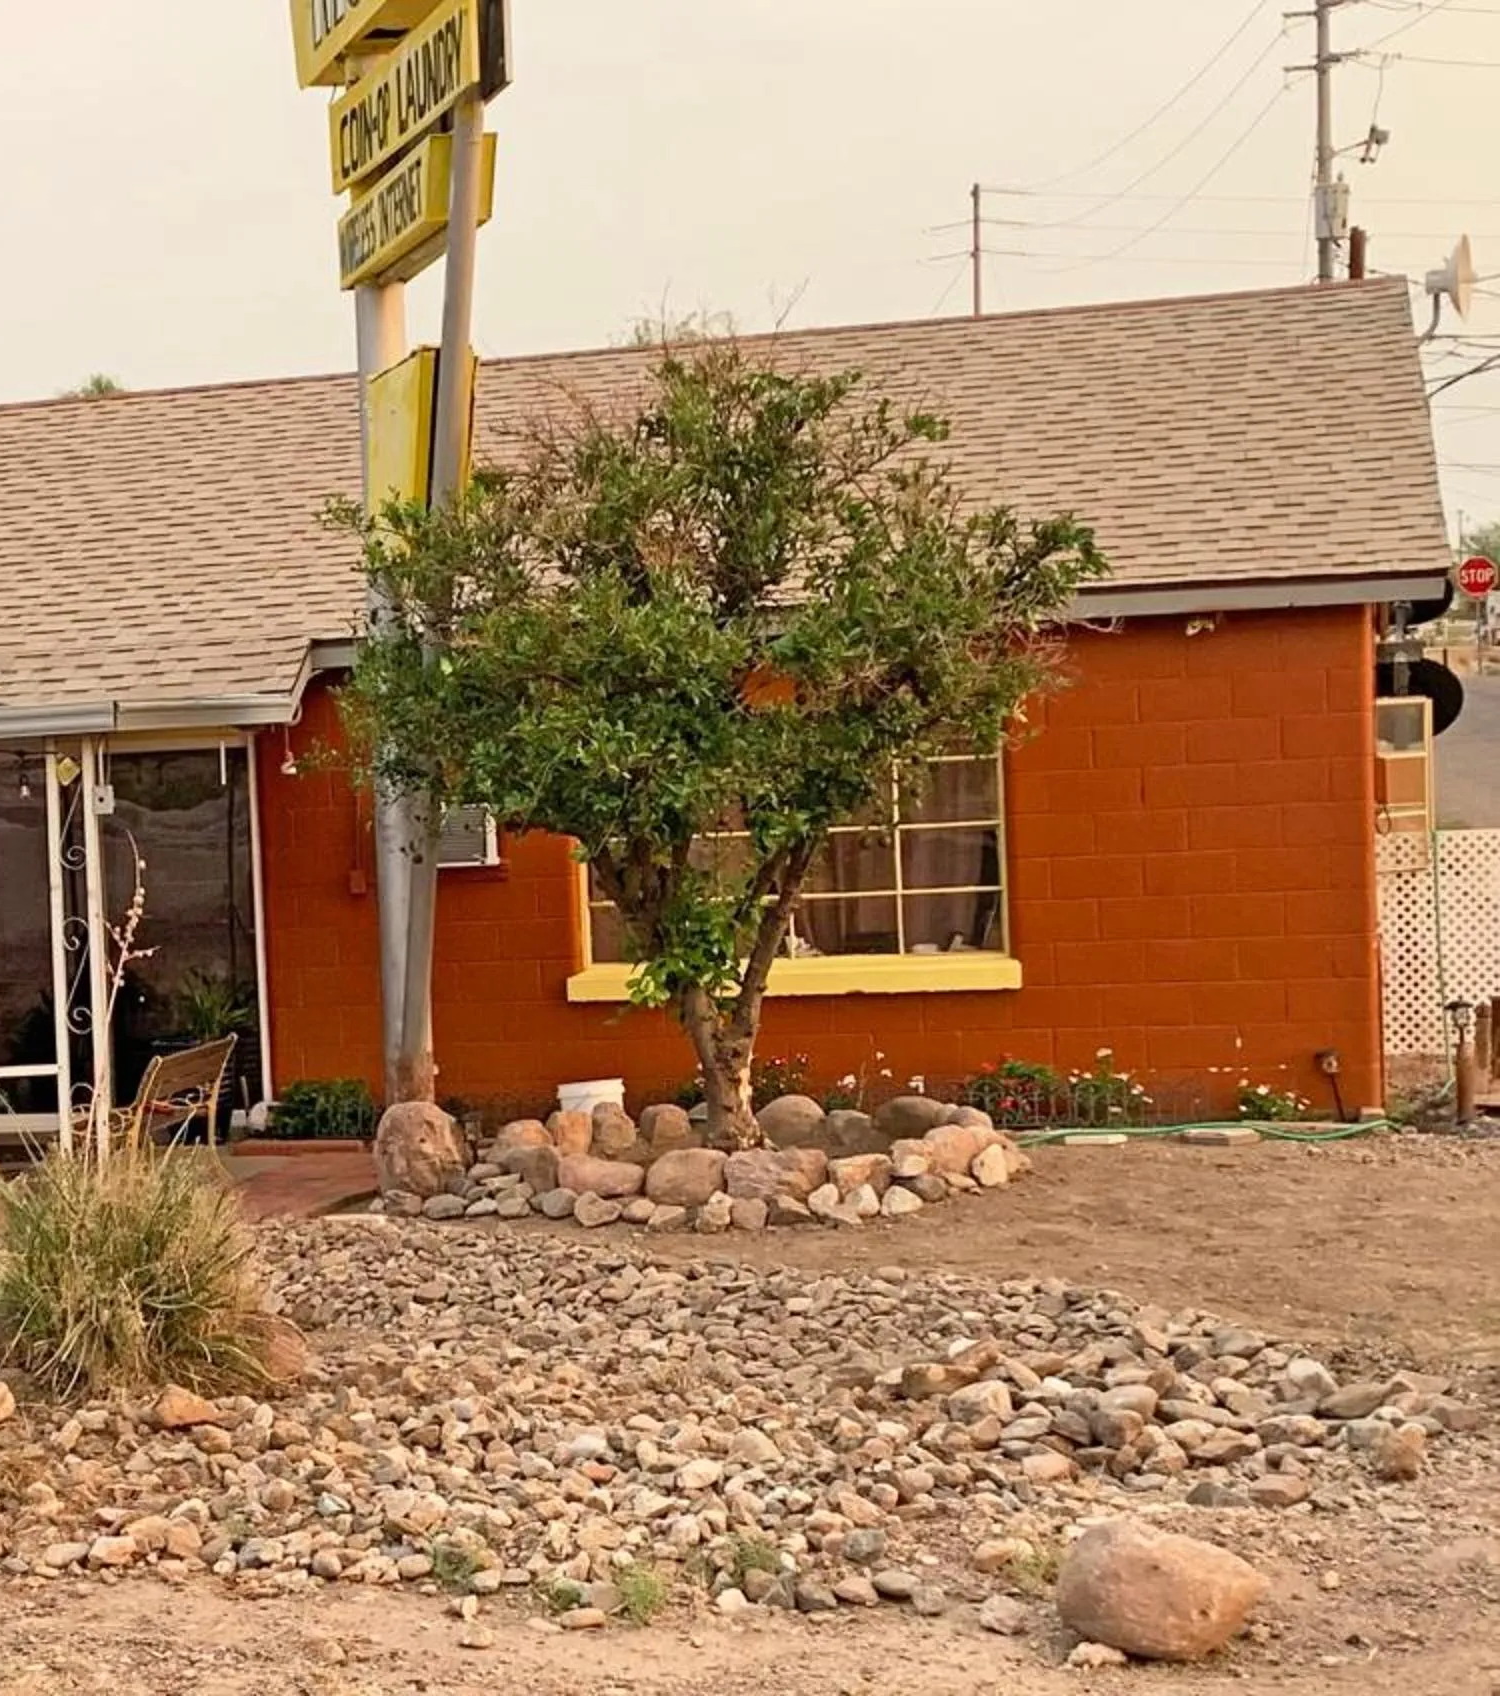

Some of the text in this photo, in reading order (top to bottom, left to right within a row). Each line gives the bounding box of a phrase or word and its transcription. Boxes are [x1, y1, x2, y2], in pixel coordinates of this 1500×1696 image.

[340, 80, 390, 179] COIN-OP
[397, 6, 464, 136] LAUNDRY
[377, 157, 423, 248] INTERNET
[1460, 567, 1494, 585] STOP
